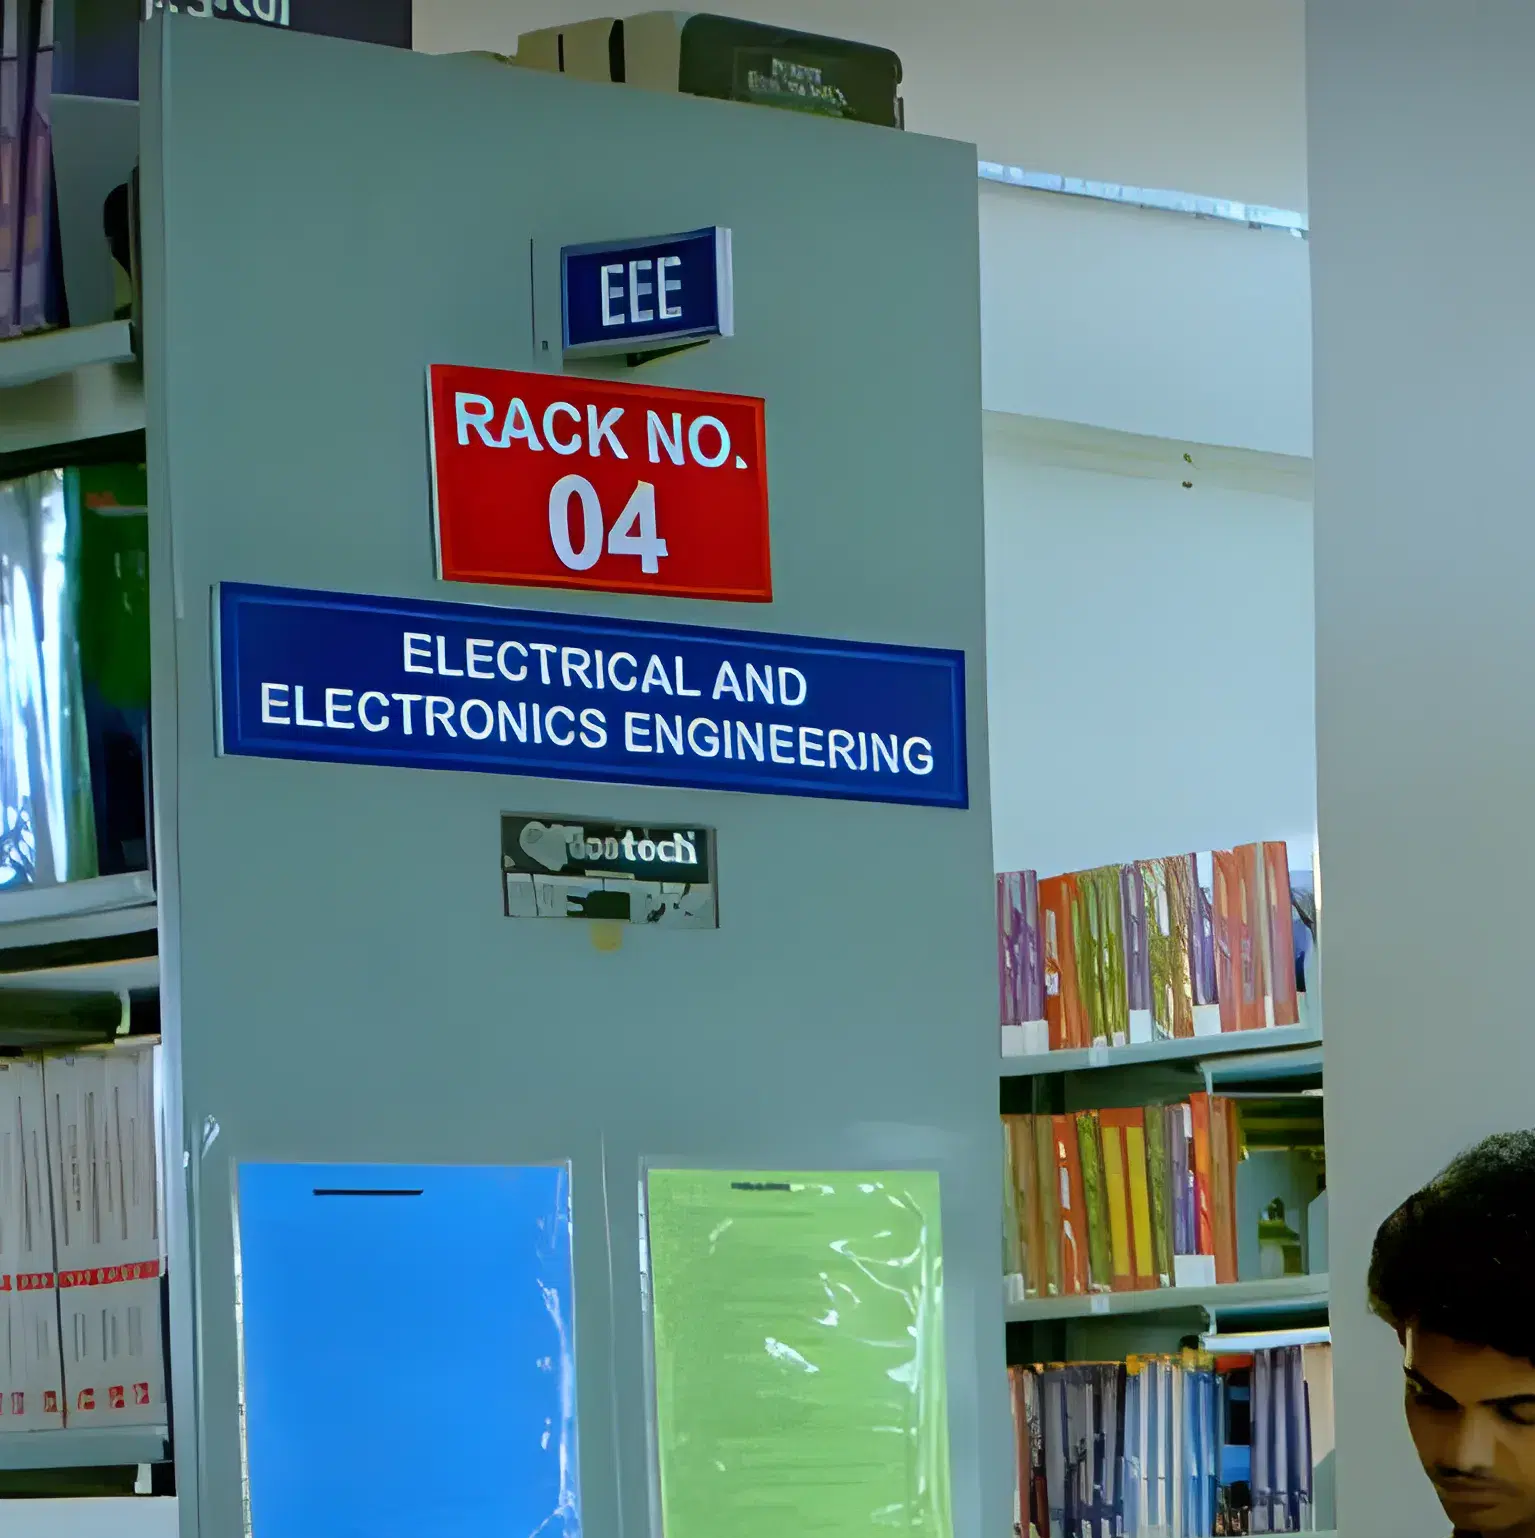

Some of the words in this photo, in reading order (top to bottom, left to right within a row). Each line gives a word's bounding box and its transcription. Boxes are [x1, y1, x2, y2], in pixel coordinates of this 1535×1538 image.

[601, 256, 682, 326] EEE
[454, 392, 628, 461] RACK
[647, 410, 748, 470] NO.
[547, 474, 669, 574] 04
[403, 632, 702, 698] ELECTRICAL
[712, 660, 808, 707] AND
[260, 683, 608, 749] ELECTRONICS
[622, 713, 935, 777] ENGINEERING
